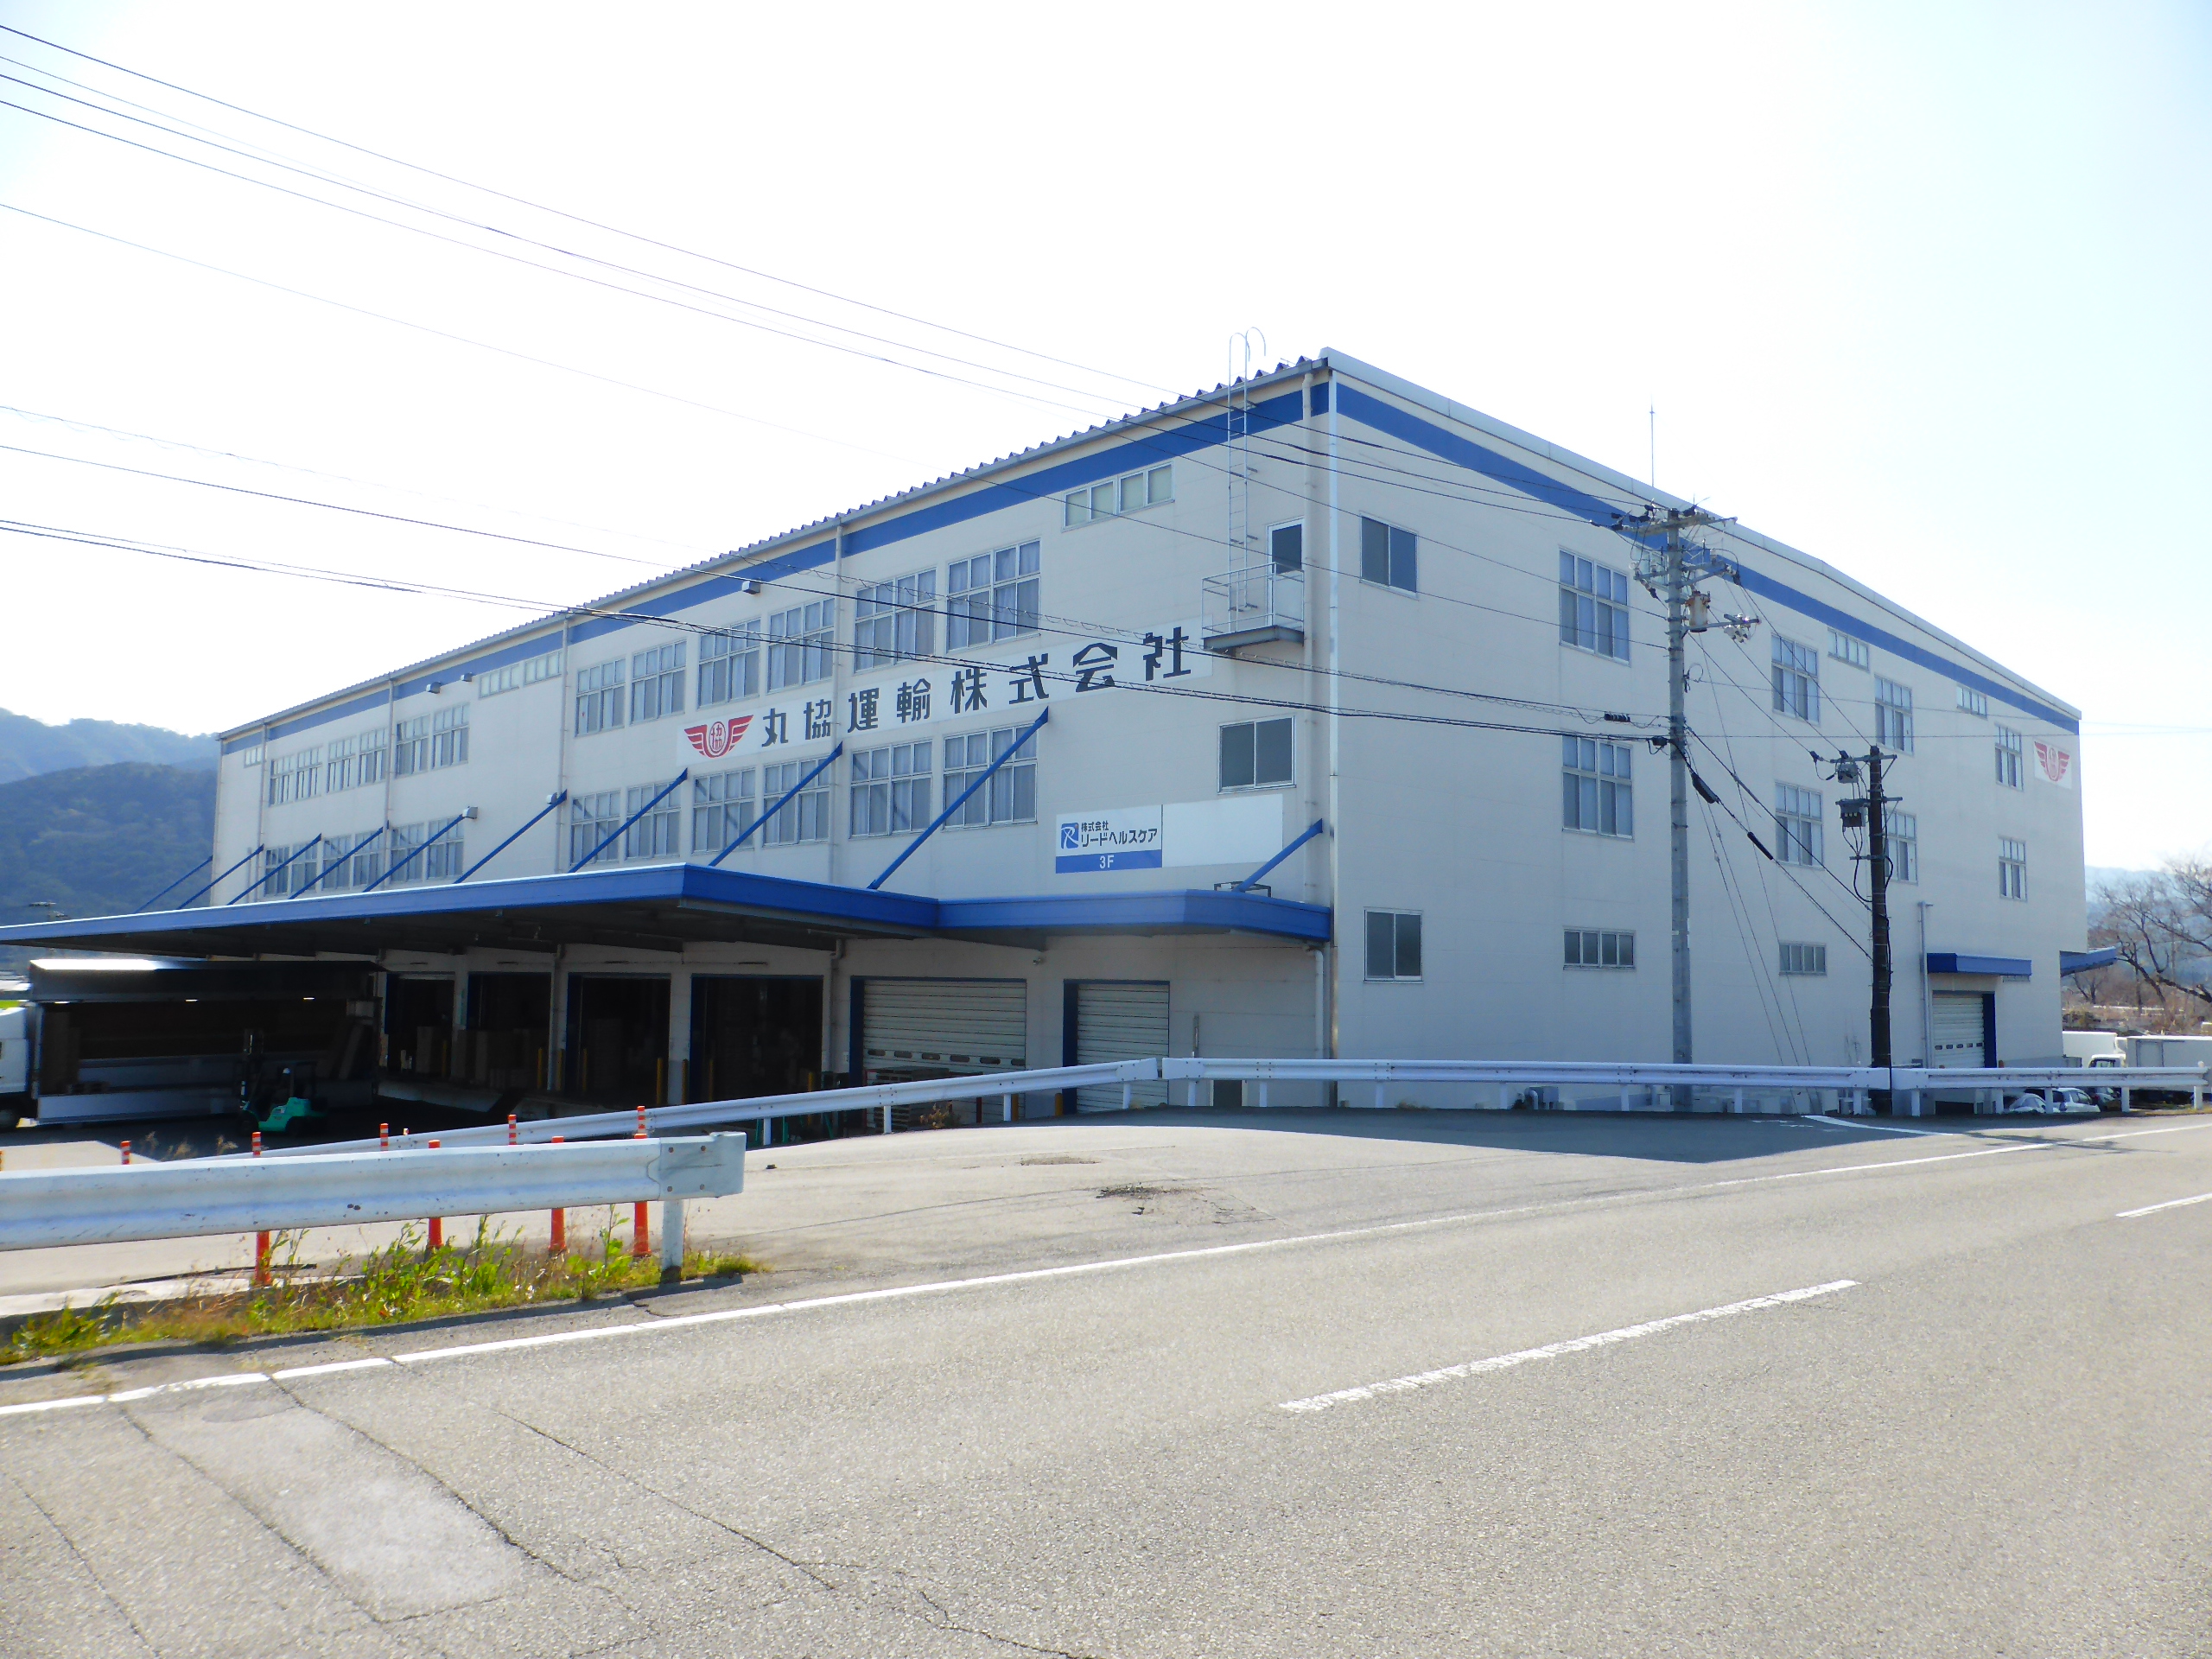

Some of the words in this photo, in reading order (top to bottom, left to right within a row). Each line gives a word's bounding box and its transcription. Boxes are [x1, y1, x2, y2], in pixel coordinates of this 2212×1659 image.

[761, 626, 1192, 747] 丸協運輸株式会社
[1081, 820, 1109, 833] 株式会社
[1081, 828, 1158, 848] リードヘルスケア
[1099, 855, 1115, 869] 3F
